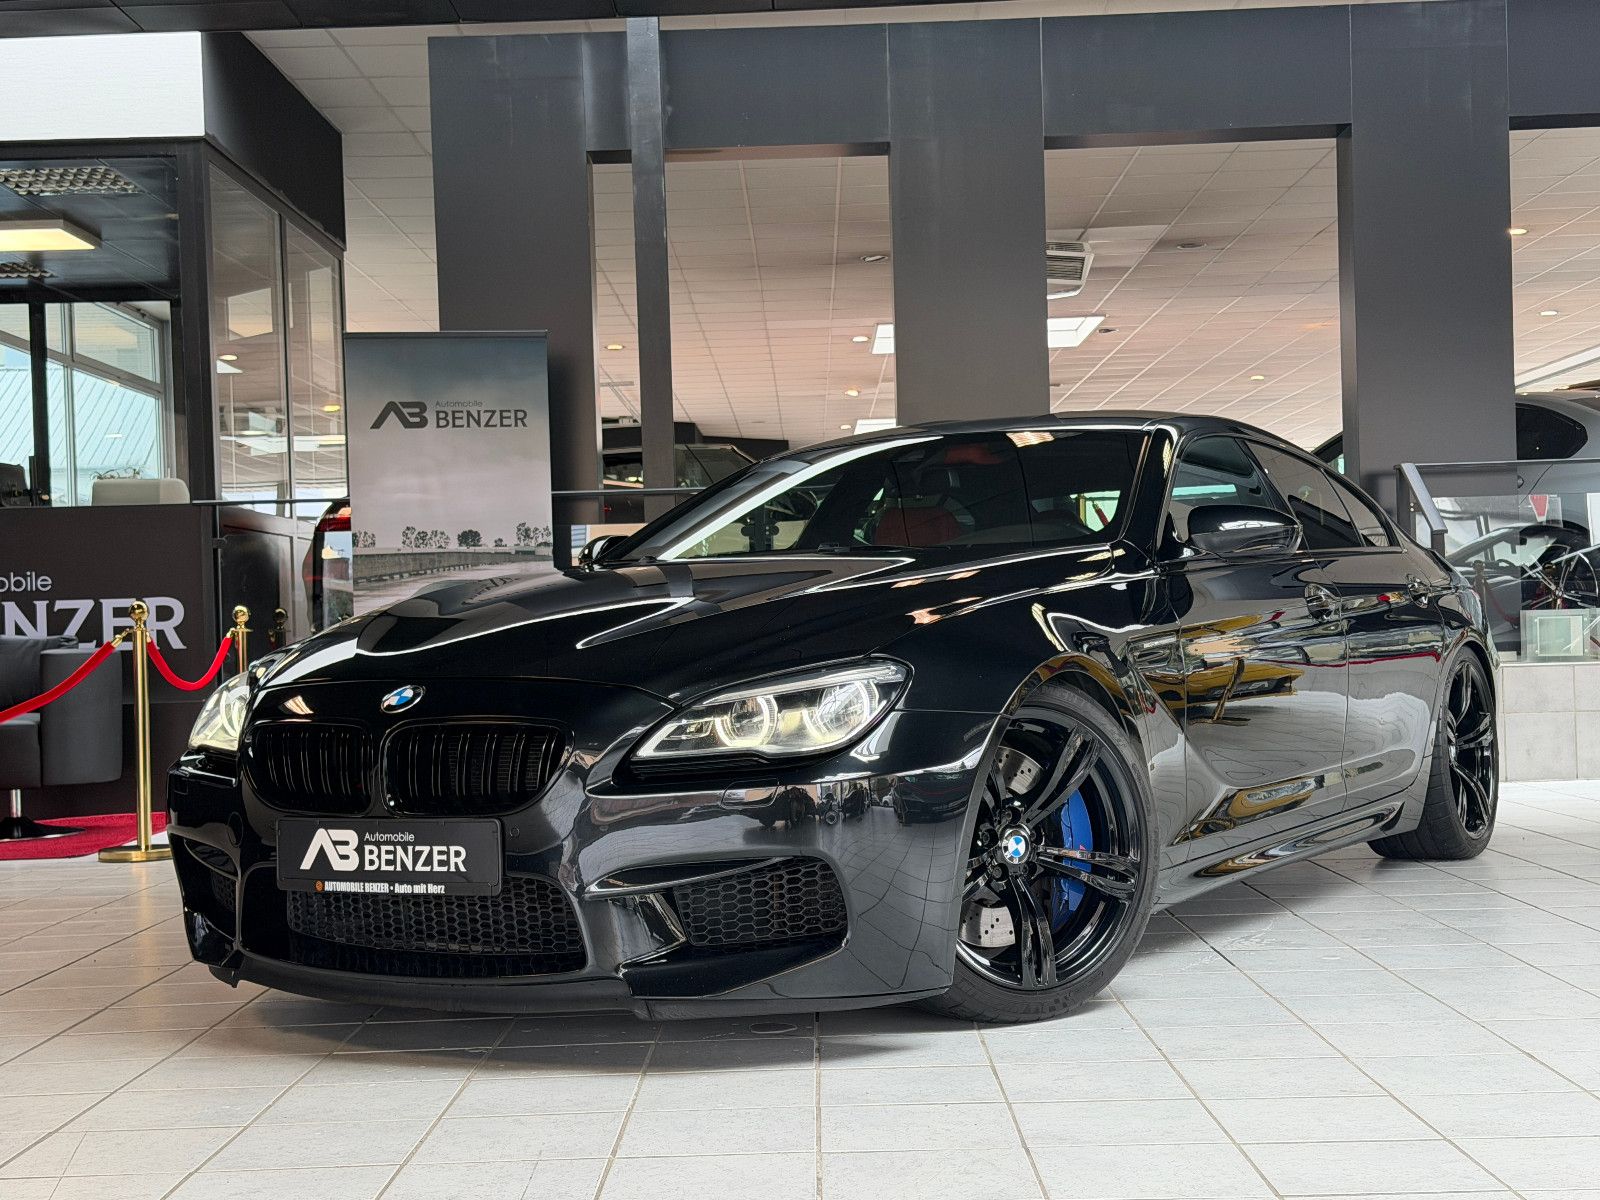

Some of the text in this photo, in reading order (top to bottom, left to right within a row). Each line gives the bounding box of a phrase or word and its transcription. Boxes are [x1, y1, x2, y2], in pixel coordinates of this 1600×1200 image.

[435, 400, 483, 408] Automobile
[435, 409, 528, 429] BENZER
[364, 832, 415, 843] Automobile
[364, 845, 467, 873] BENZER
[324, 880, 445, 894] AUTOMOBILE BENZER Auto mit Herz
